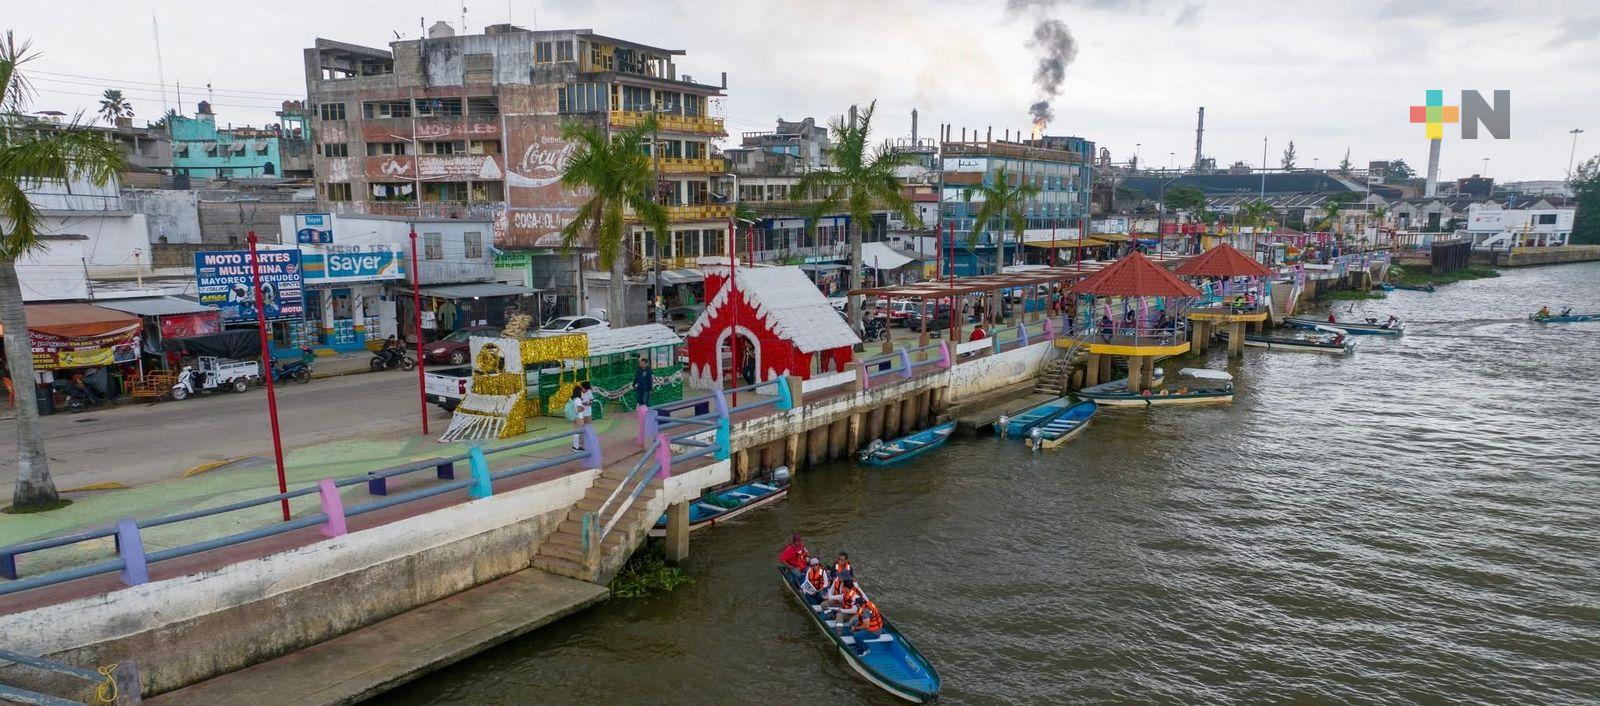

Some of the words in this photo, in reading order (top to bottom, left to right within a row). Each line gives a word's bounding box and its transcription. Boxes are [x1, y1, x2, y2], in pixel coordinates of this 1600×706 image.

[205, 254, 241, 265] MOTO
[330, 254, 381, 274] Sayer
[201, 276, 246, 285] MAYOREO
[258, 273, 300, 282] MENUDEO
